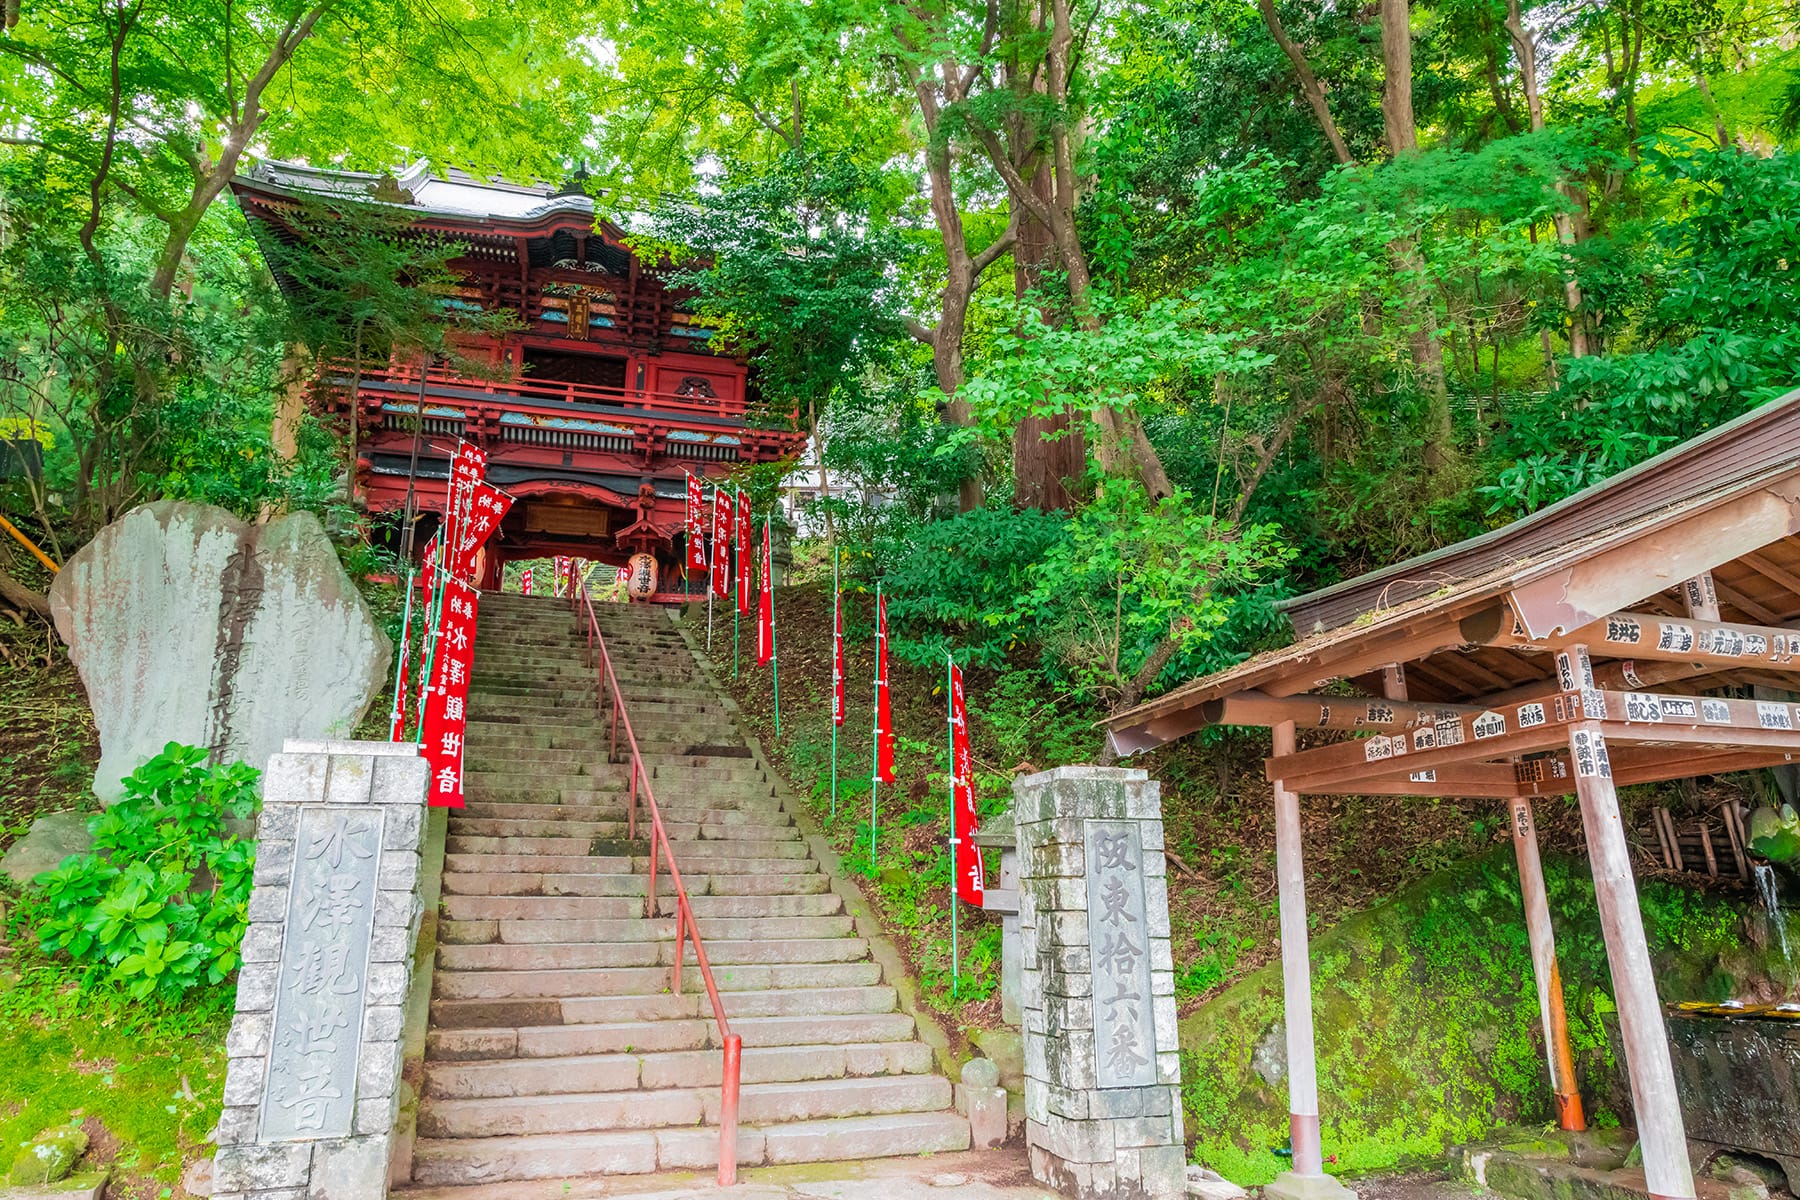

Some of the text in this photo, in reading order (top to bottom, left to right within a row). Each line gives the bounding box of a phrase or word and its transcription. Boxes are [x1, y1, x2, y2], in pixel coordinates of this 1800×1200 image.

[1093, 828, 1150, 1080] 阪東拾六番
